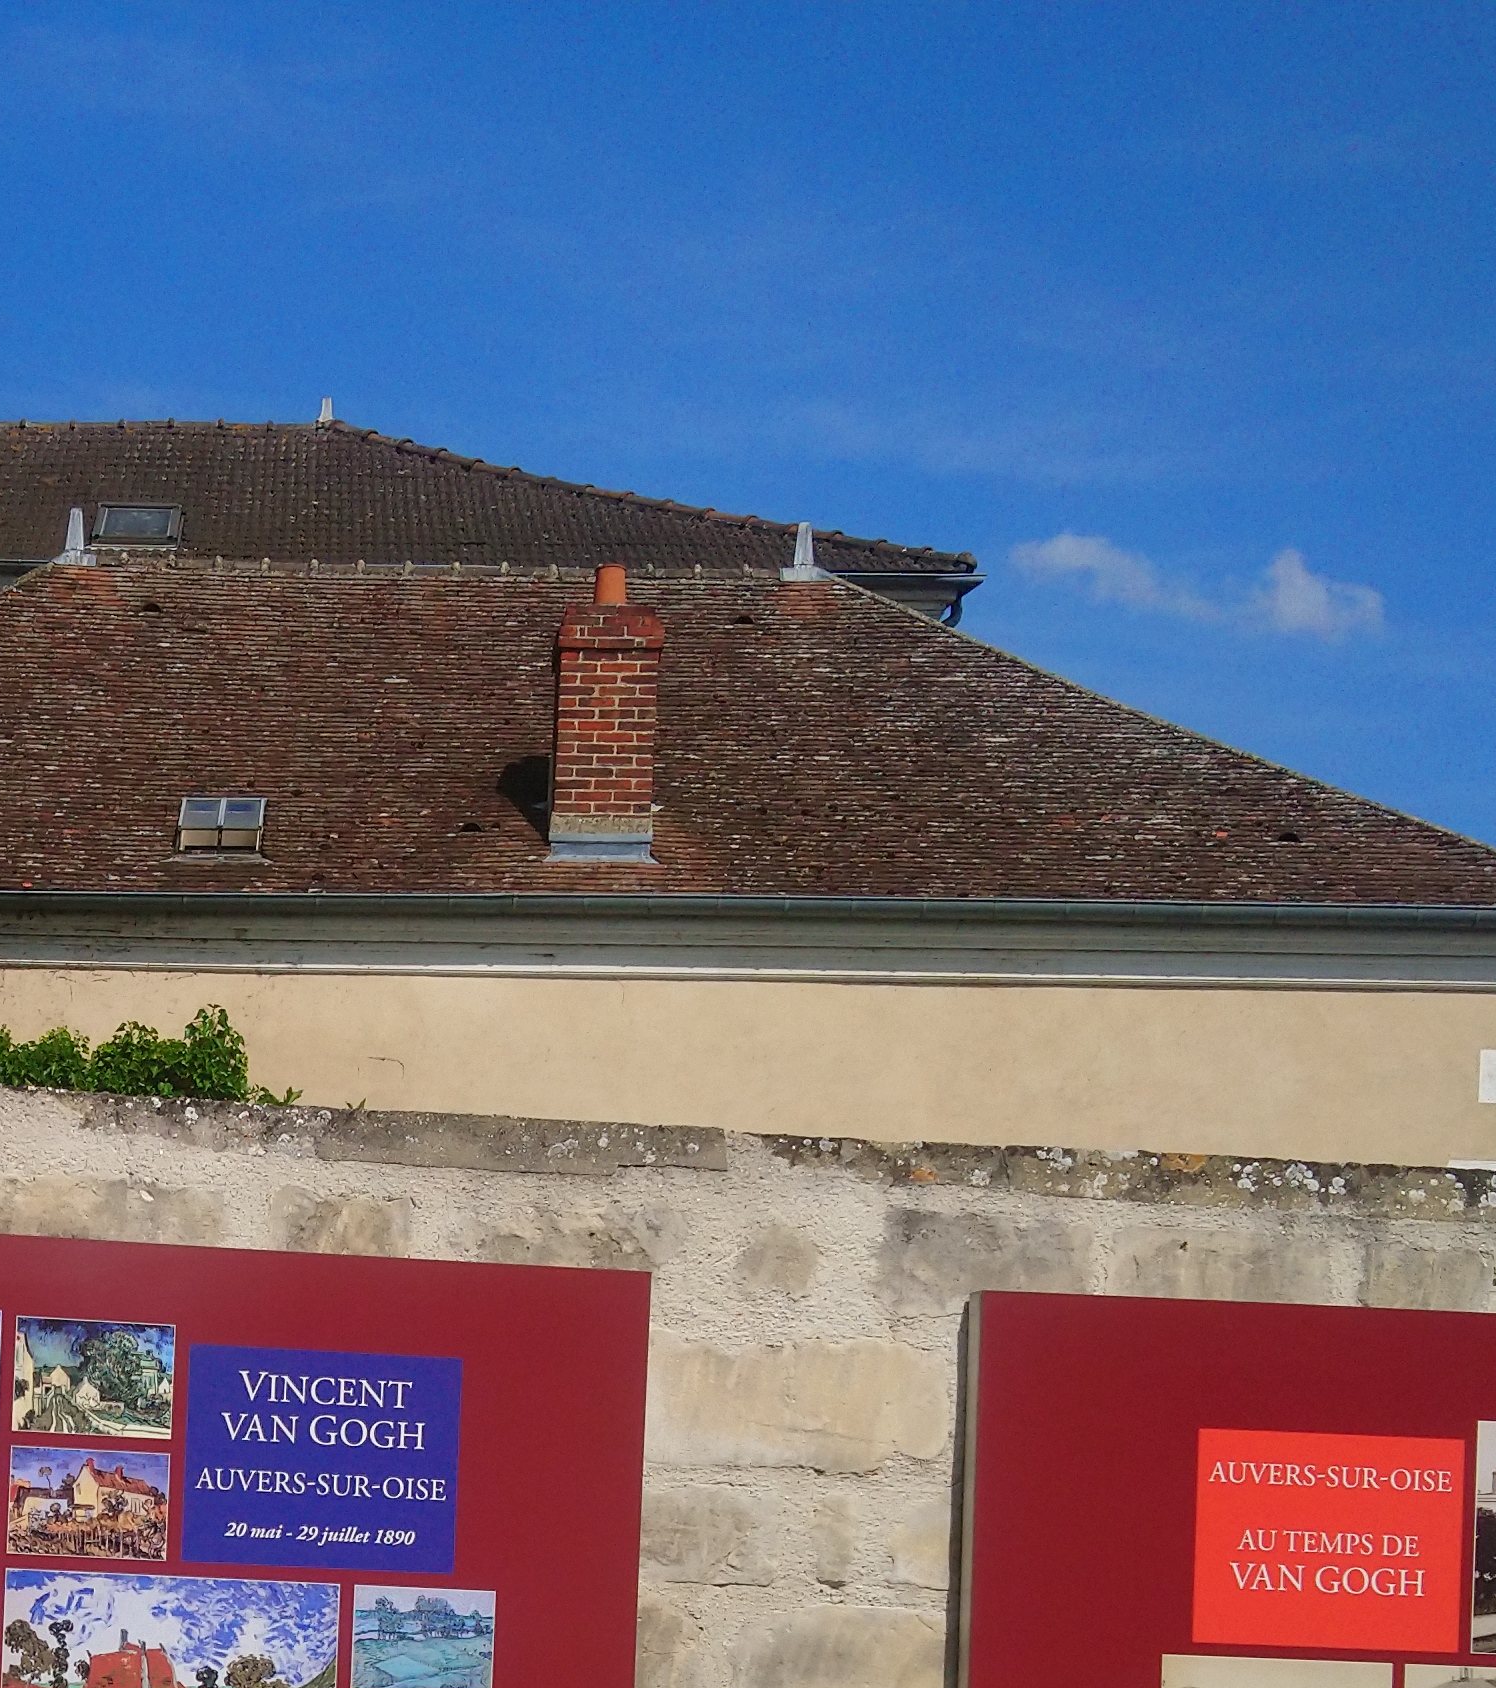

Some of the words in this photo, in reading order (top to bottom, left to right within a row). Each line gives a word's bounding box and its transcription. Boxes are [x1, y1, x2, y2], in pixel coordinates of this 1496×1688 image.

[239, 1370, 413, 1410] VINCENT
[221, 1412, 299, 1444] VAN
[309, 1415, 426, 1450] GOGH
[195, 1467, 447, 1501] AUVERS-SUR-OISE
[1209, 1461, 1453, 1492] AUVERS-SUR-OISE
[224, 1522, 247, 1538] 20
[250, 1525, 283, 1540] mai
[296, 1526, 318, 1541] 29
[317, 1526, 370, 1546] juillet
[374, 1529, 416, 1546] 1890
[1237, 1529, 1278, 1551] AU
[1283, 1530, 1374, 1556] TEMPS
[1382, 1535, 1420, 1557] DE
[1230, 1562, 1305, 1592] VAN
[1315, 1566, 1425, 1597] GOGH
